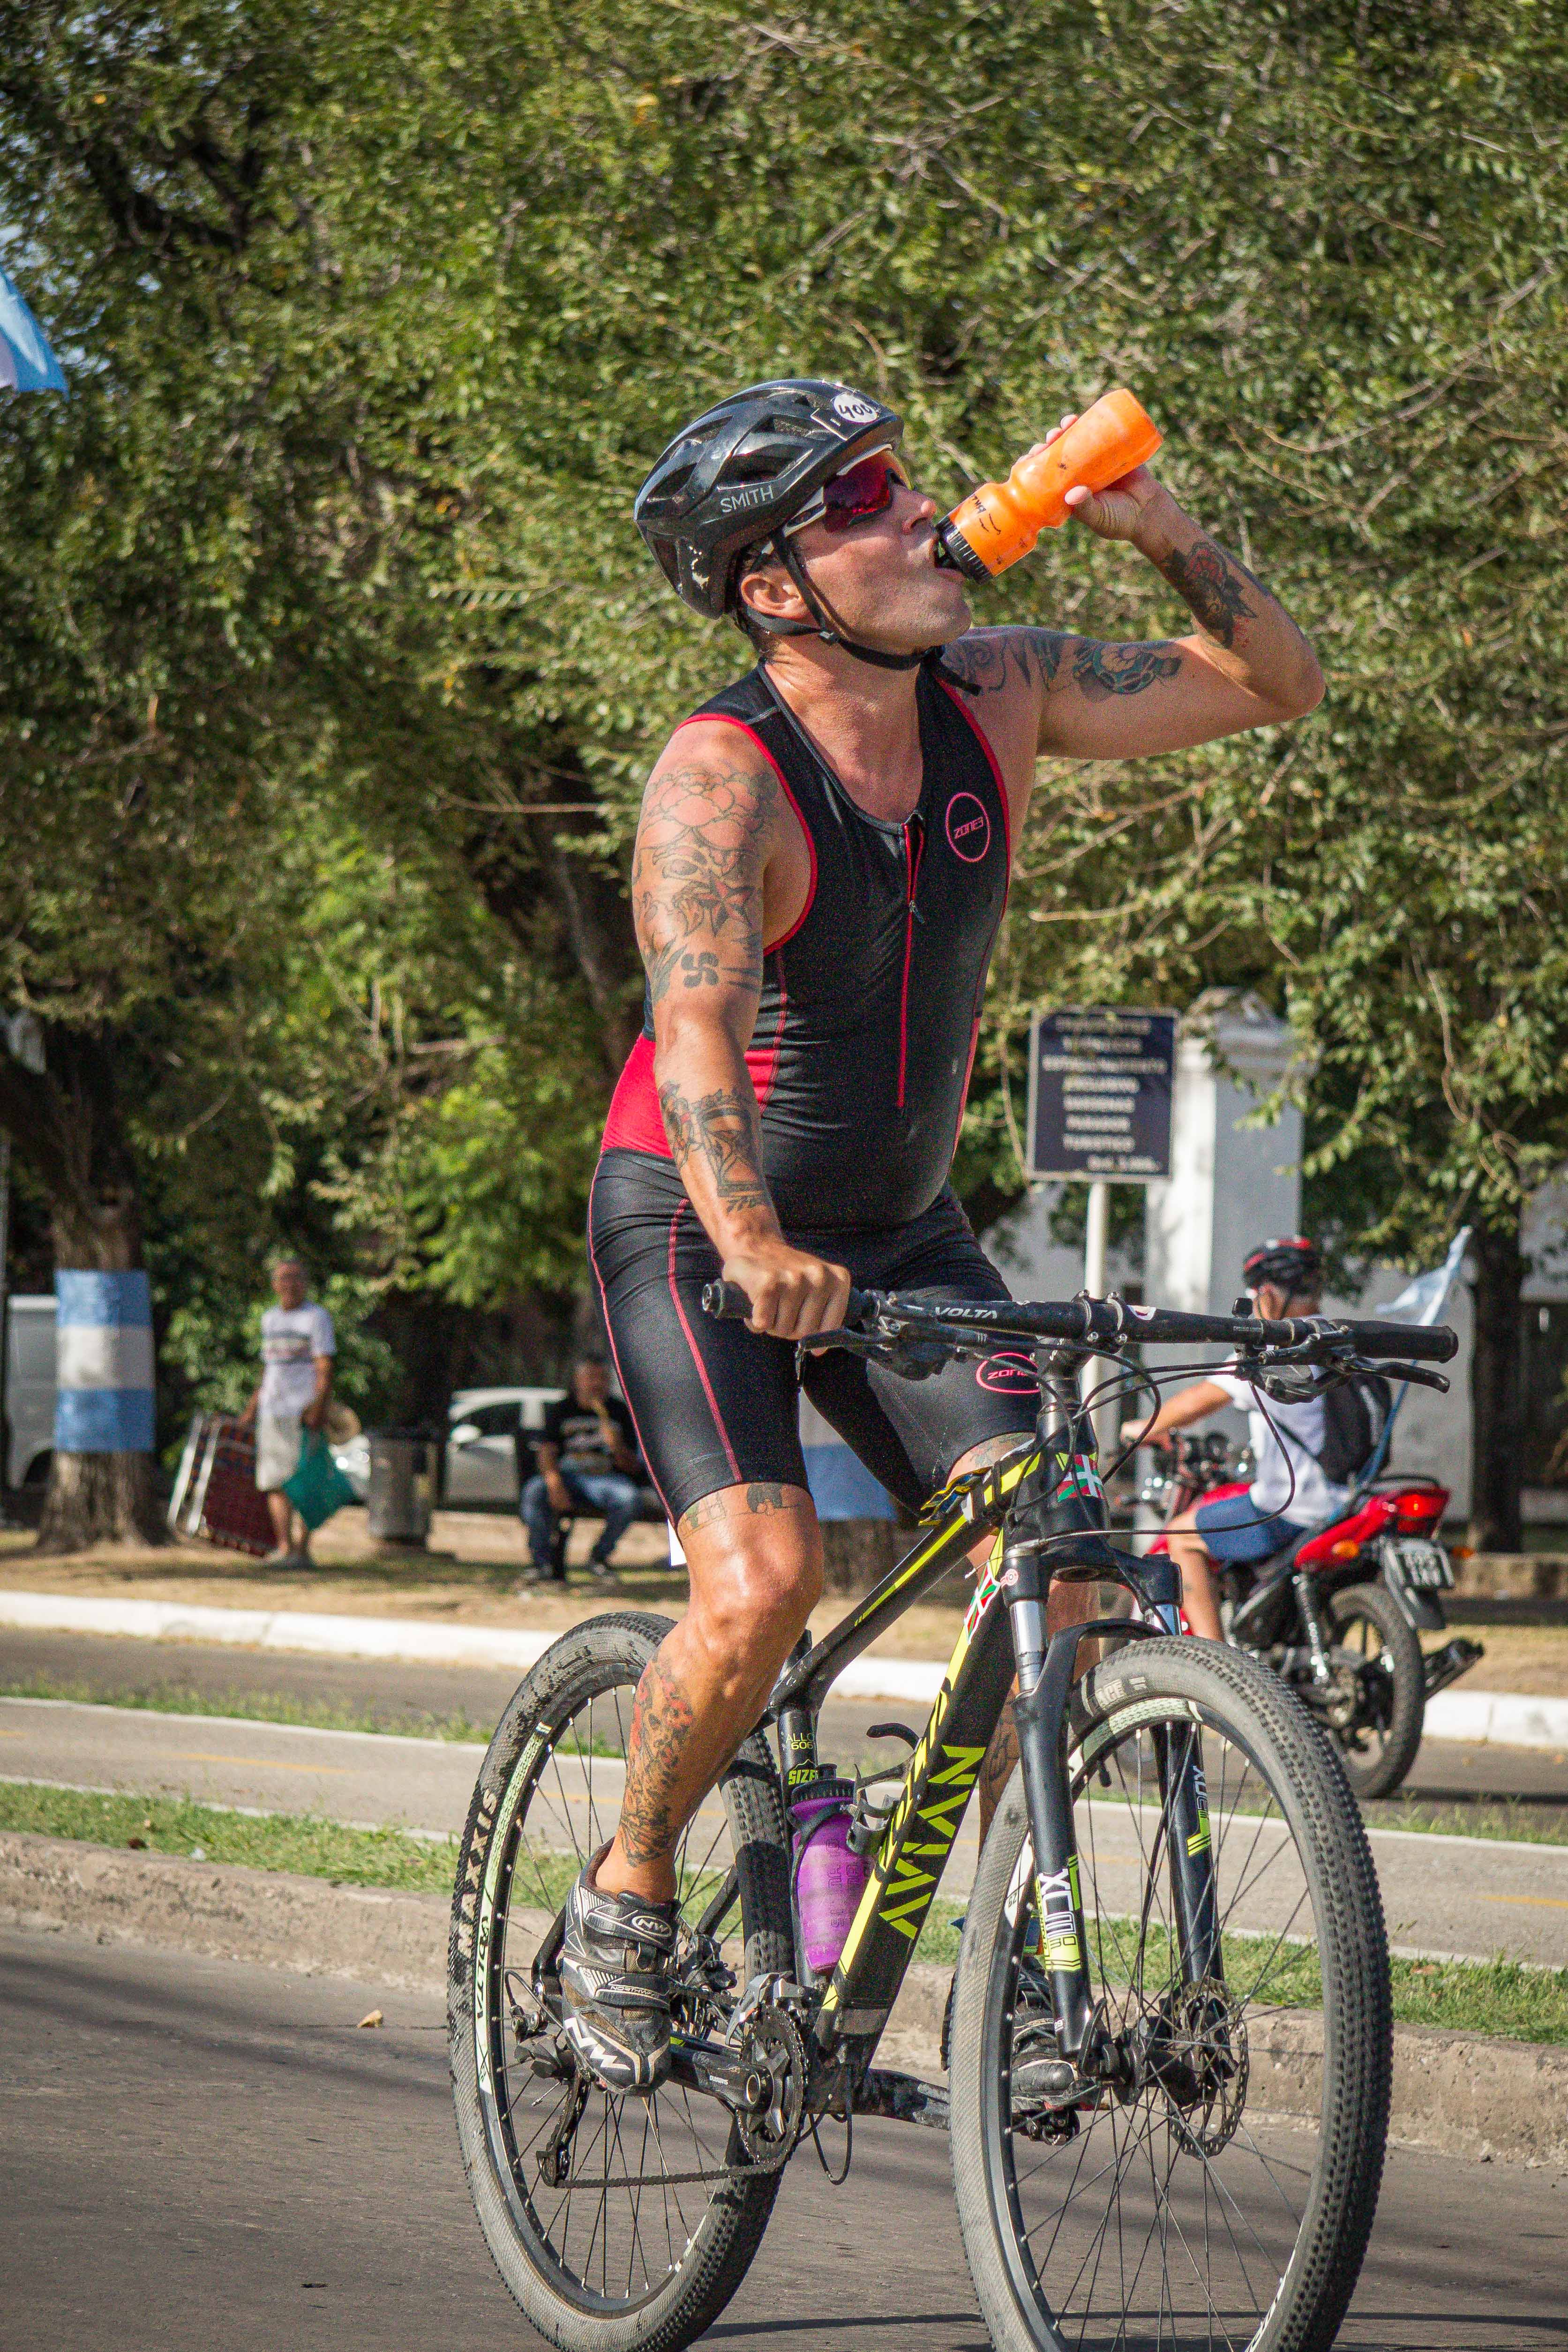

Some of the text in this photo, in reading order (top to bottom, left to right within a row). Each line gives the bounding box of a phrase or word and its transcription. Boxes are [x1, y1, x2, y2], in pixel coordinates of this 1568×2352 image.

[838, 404, 873, 419] 400
[720, 484, 774, 513] SMITH
[935, 1306, 998, 1319] VOLTA
[457, 1788, 497, 1959] MAXXIS
[1038, 1868, 1077, 1939] XCM
